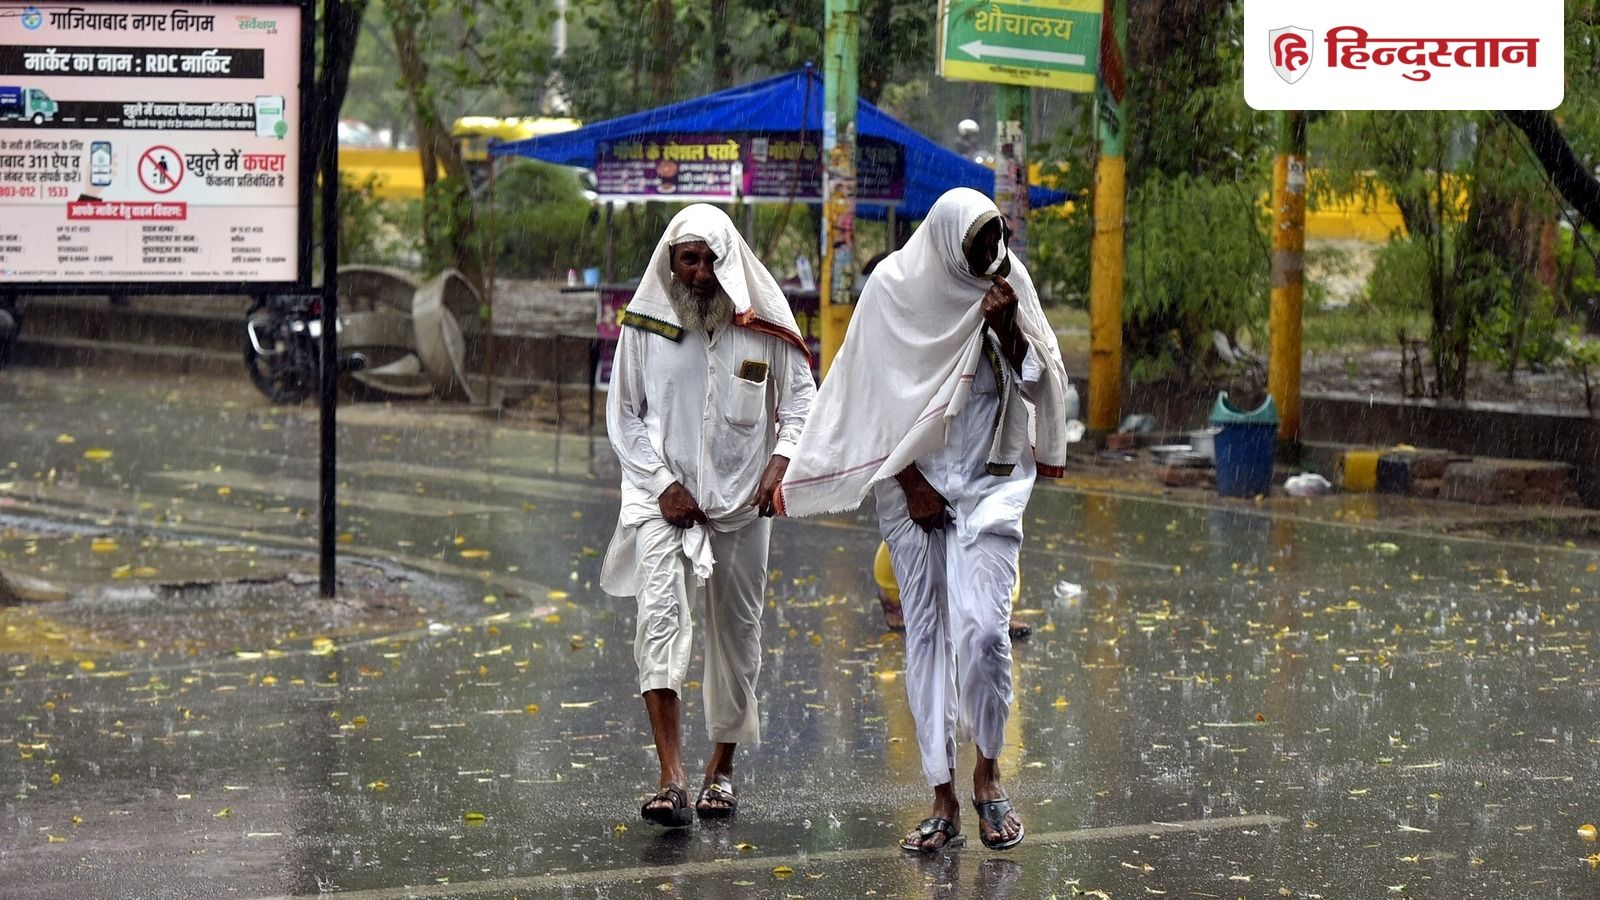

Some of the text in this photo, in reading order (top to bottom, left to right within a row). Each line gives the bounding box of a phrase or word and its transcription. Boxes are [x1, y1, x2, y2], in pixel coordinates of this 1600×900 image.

[50, 8, 215, 32] गाजियाबाद नगर निगम
[974, 4, 1074, 41] शौचालय
[24, 48, 70, 72] मार्केट
[73, 53, 94, 72] का
[96, 53, 132, 72] नाम
[145, 54, 178, 72] RDC
[28, 155, 47, 168] 311
[51, 151, 68, 168] ऐप
[71, 156, 80, 168] व
[185, 148, 286, 177] खुले में कचरा
[25, 172, 37, 182] पर
[48, 186, 68, 197] 1533
